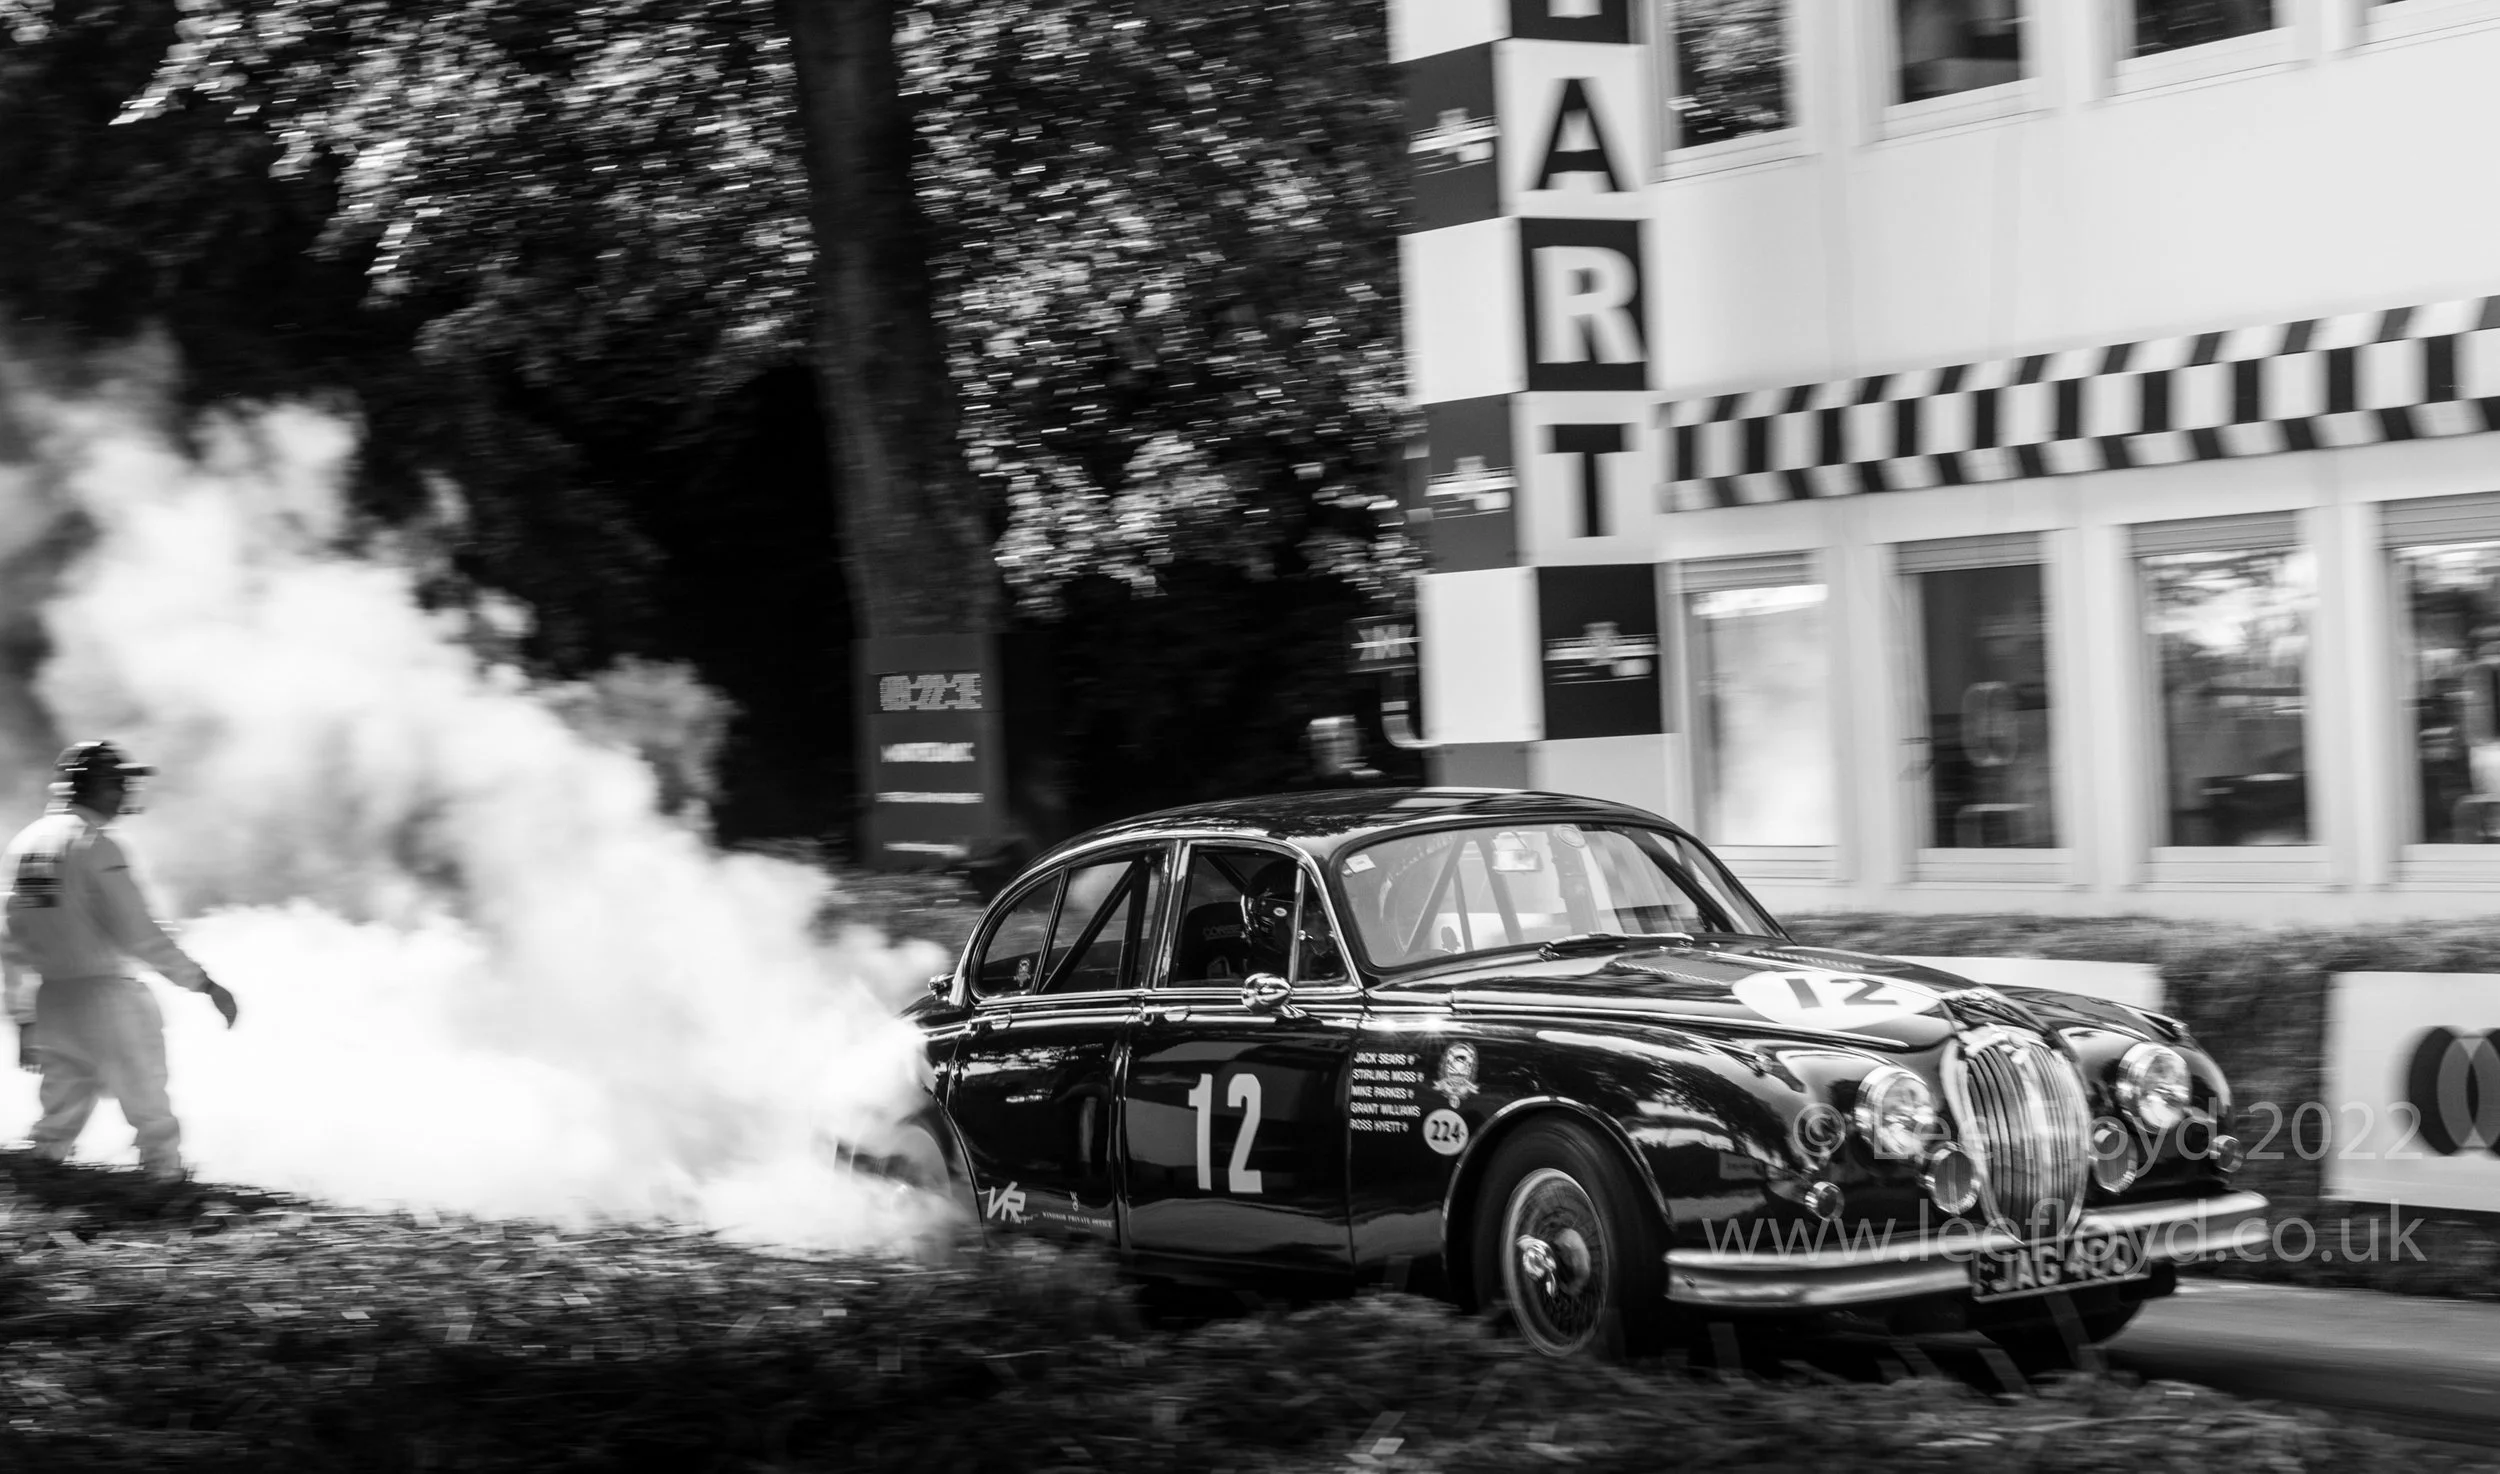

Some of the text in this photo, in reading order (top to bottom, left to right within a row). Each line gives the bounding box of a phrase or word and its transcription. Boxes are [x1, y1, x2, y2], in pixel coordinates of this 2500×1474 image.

[1530, 0, 1648, 539] ART
[1784, 977, 1898, 1009] 12
[1354, 1052, 1407, 1065] JACK SEARS
[1352, 1068, 1417, 1083] STIRLING MOSS
[1351, 1085, 1407, 1099] MIKE PARKES
[1350, 1101, 1421, 1117] GRANT WILLIAMS
[1349, 1118, 1373, 1131] ROSS
[1430, 1119, 1466, 1143] 224
[1188, 1072, 1263, 1194] 12
